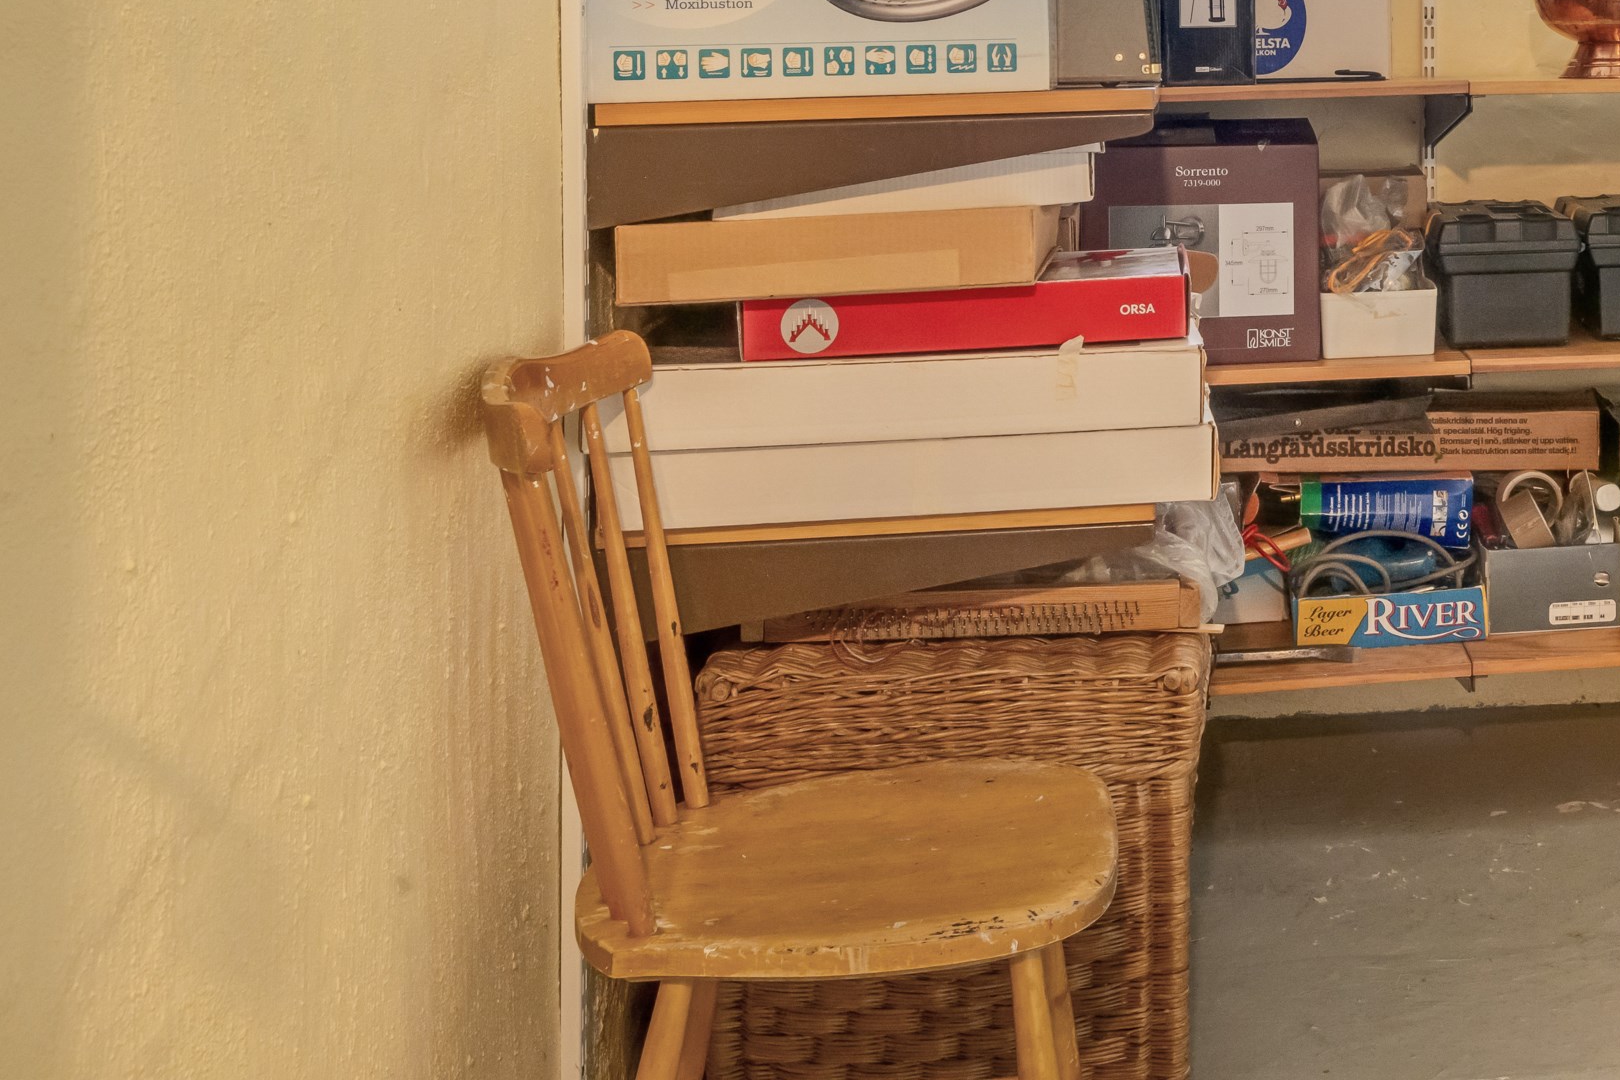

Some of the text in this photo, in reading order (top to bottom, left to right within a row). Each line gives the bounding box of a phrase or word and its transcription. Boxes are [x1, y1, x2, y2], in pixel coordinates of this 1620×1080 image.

[1256, 37, 1290, 49] ELSTA
[1175, 165, 1229, 177] Sorrento
[1183, 179, 1221, 187] 7319-000
[1119, 303, 1156, 316] ORSA
[1259, 337, 1292, 347] SMIDE
[1487, 427, 1503, 435] Hög
[1222, 436, 1435, 464] Långfärdsskridsko
[1440, 447, 1460, 455] Stark
[1462, 447, 1509, 455] konstruktion
[1528, 446, 1547, 455] sitter
[1304, 605, 1352, 623] Lager
[1364, 598, 1482, 637] RIVER
[1304, 624, 1345, 638] Beer
